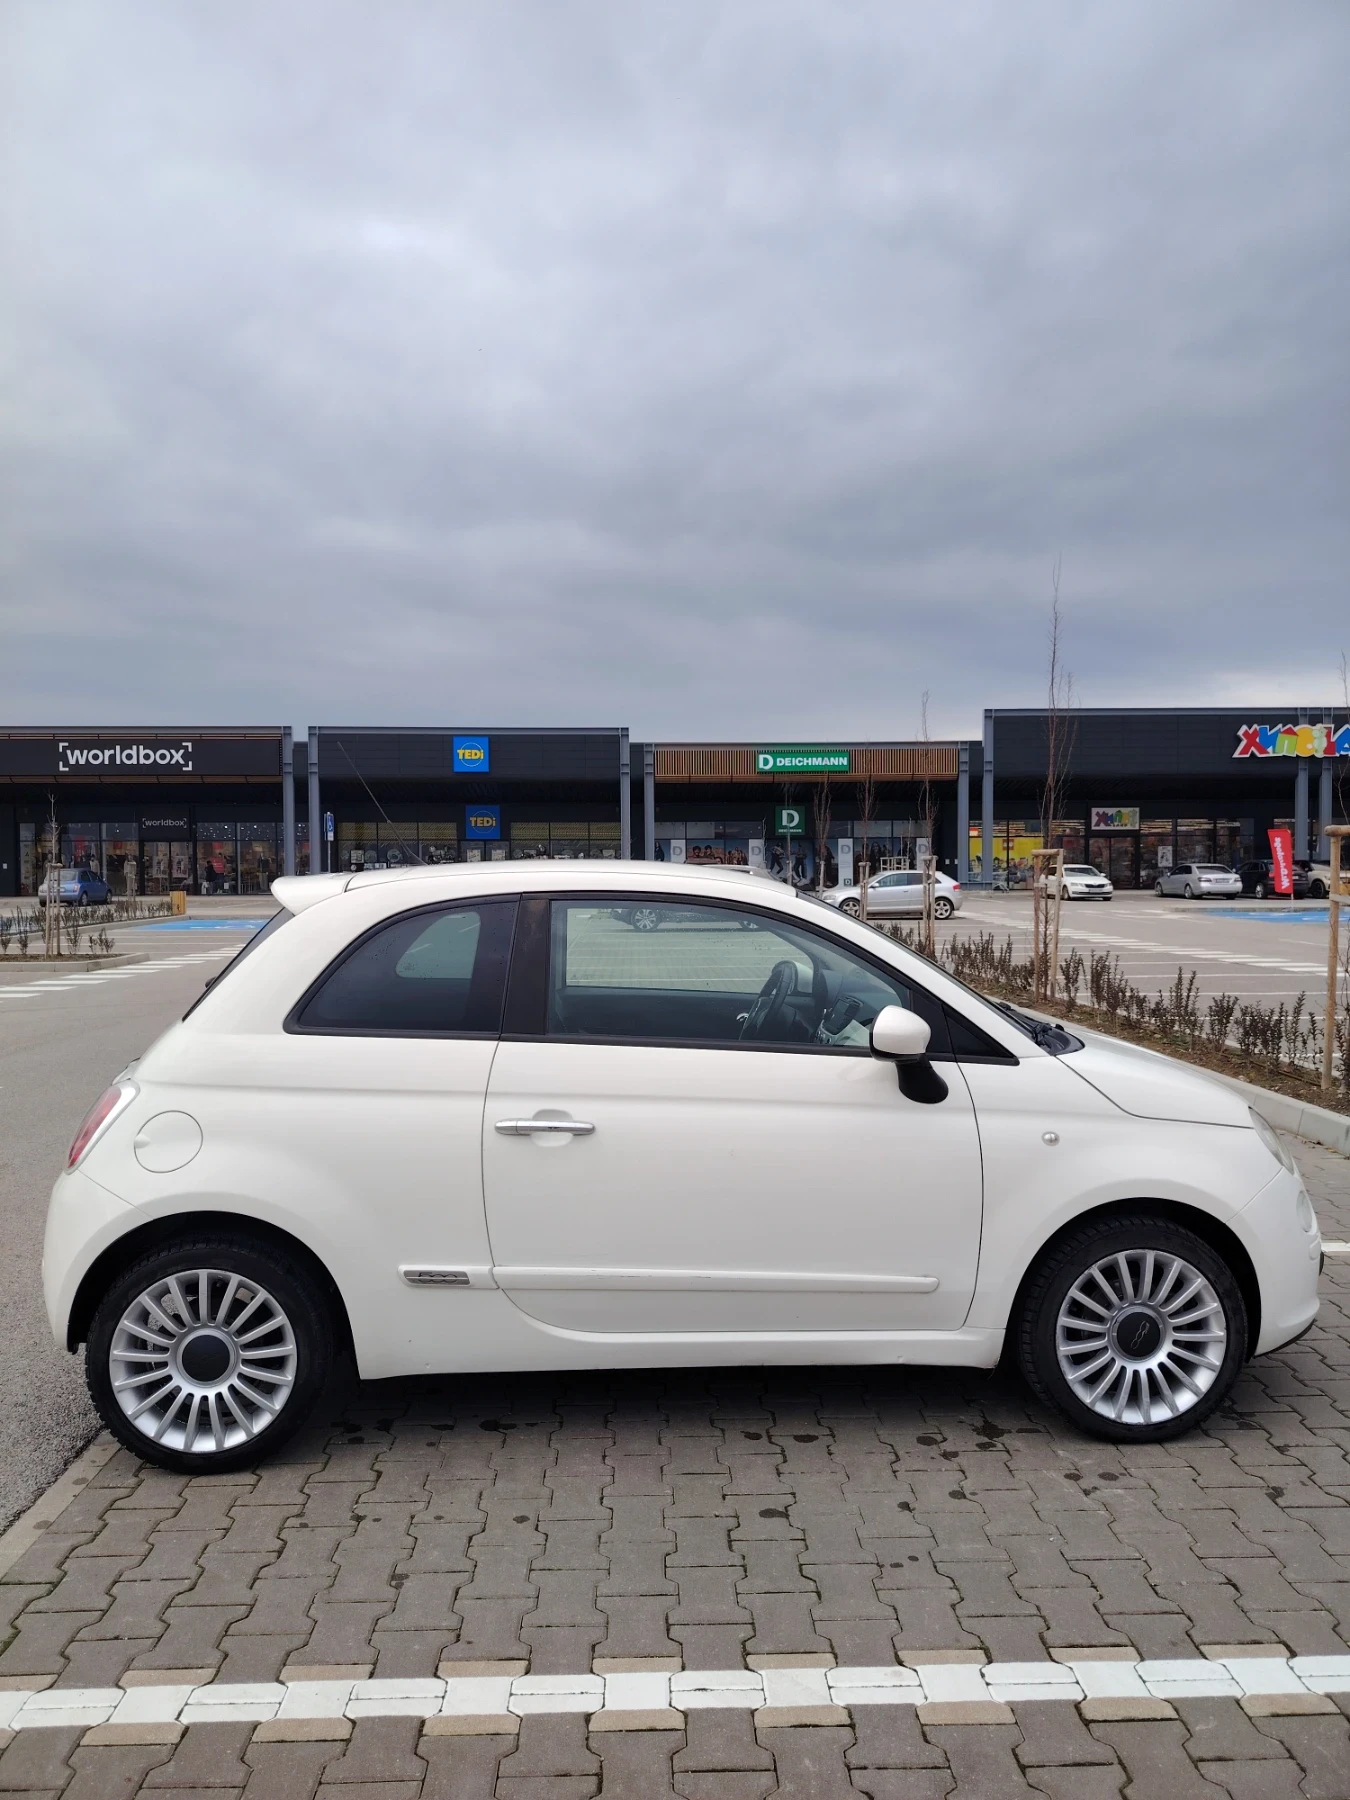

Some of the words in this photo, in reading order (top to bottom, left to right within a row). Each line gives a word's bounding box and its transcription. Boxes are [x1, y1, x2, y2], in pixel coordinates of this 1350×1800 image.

[457, 749, 484, 760] TEDi
[758, 754, 774, 770] D
[776, 757, 848, 767] DEICHMANN
[469, 817, 496, 827] TEDi
[782, 809, 800, 828] D
[672, 846, 683, 856] D
[751, 846, 762, 856] D
[840, 844, 851, 855] D
